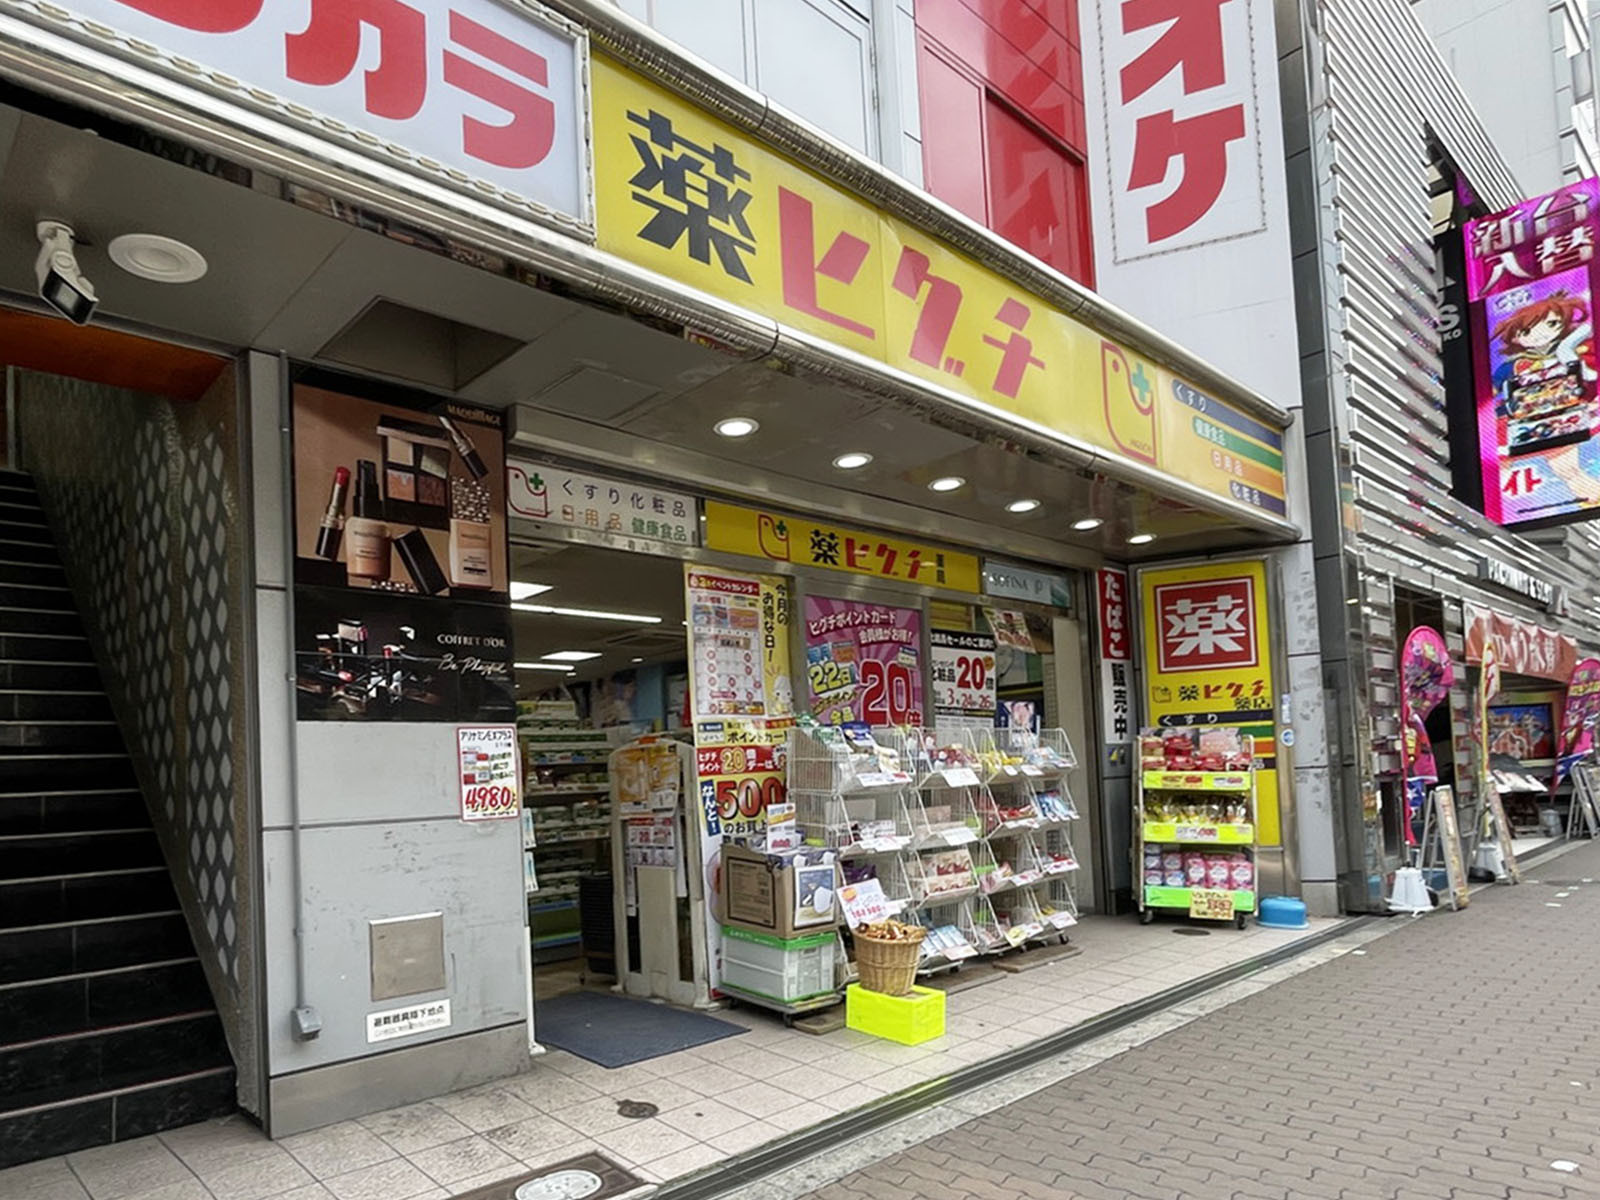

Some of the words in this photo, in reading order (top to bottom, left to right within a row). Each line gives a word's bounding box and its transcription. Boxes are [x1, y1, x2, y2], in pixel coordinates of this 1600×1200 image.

[1471, 192, 1592, 258] 新台
[1479, 226, 1595, 296] 入替
[1175, 384, 1208, 413] くすり
[562, 504, 622, 531] 日用品
[631, 517, 687, 542] 健康食品
[809, 611, 896, 635] ヒグチポイントカード
[1104, 573, 1125, 658] たばこ
[1164, 594, 1247, 657] 薬
[957, 656, 985, 690] 20
[1111, 662, 1128, 740] 販売中
[1163, 713, 1218, 726] くすり
[728, 730, 787, 744] ポイントカー
[721, 747, 746, 773] 20
[465, 785, 511, 810] 4980
